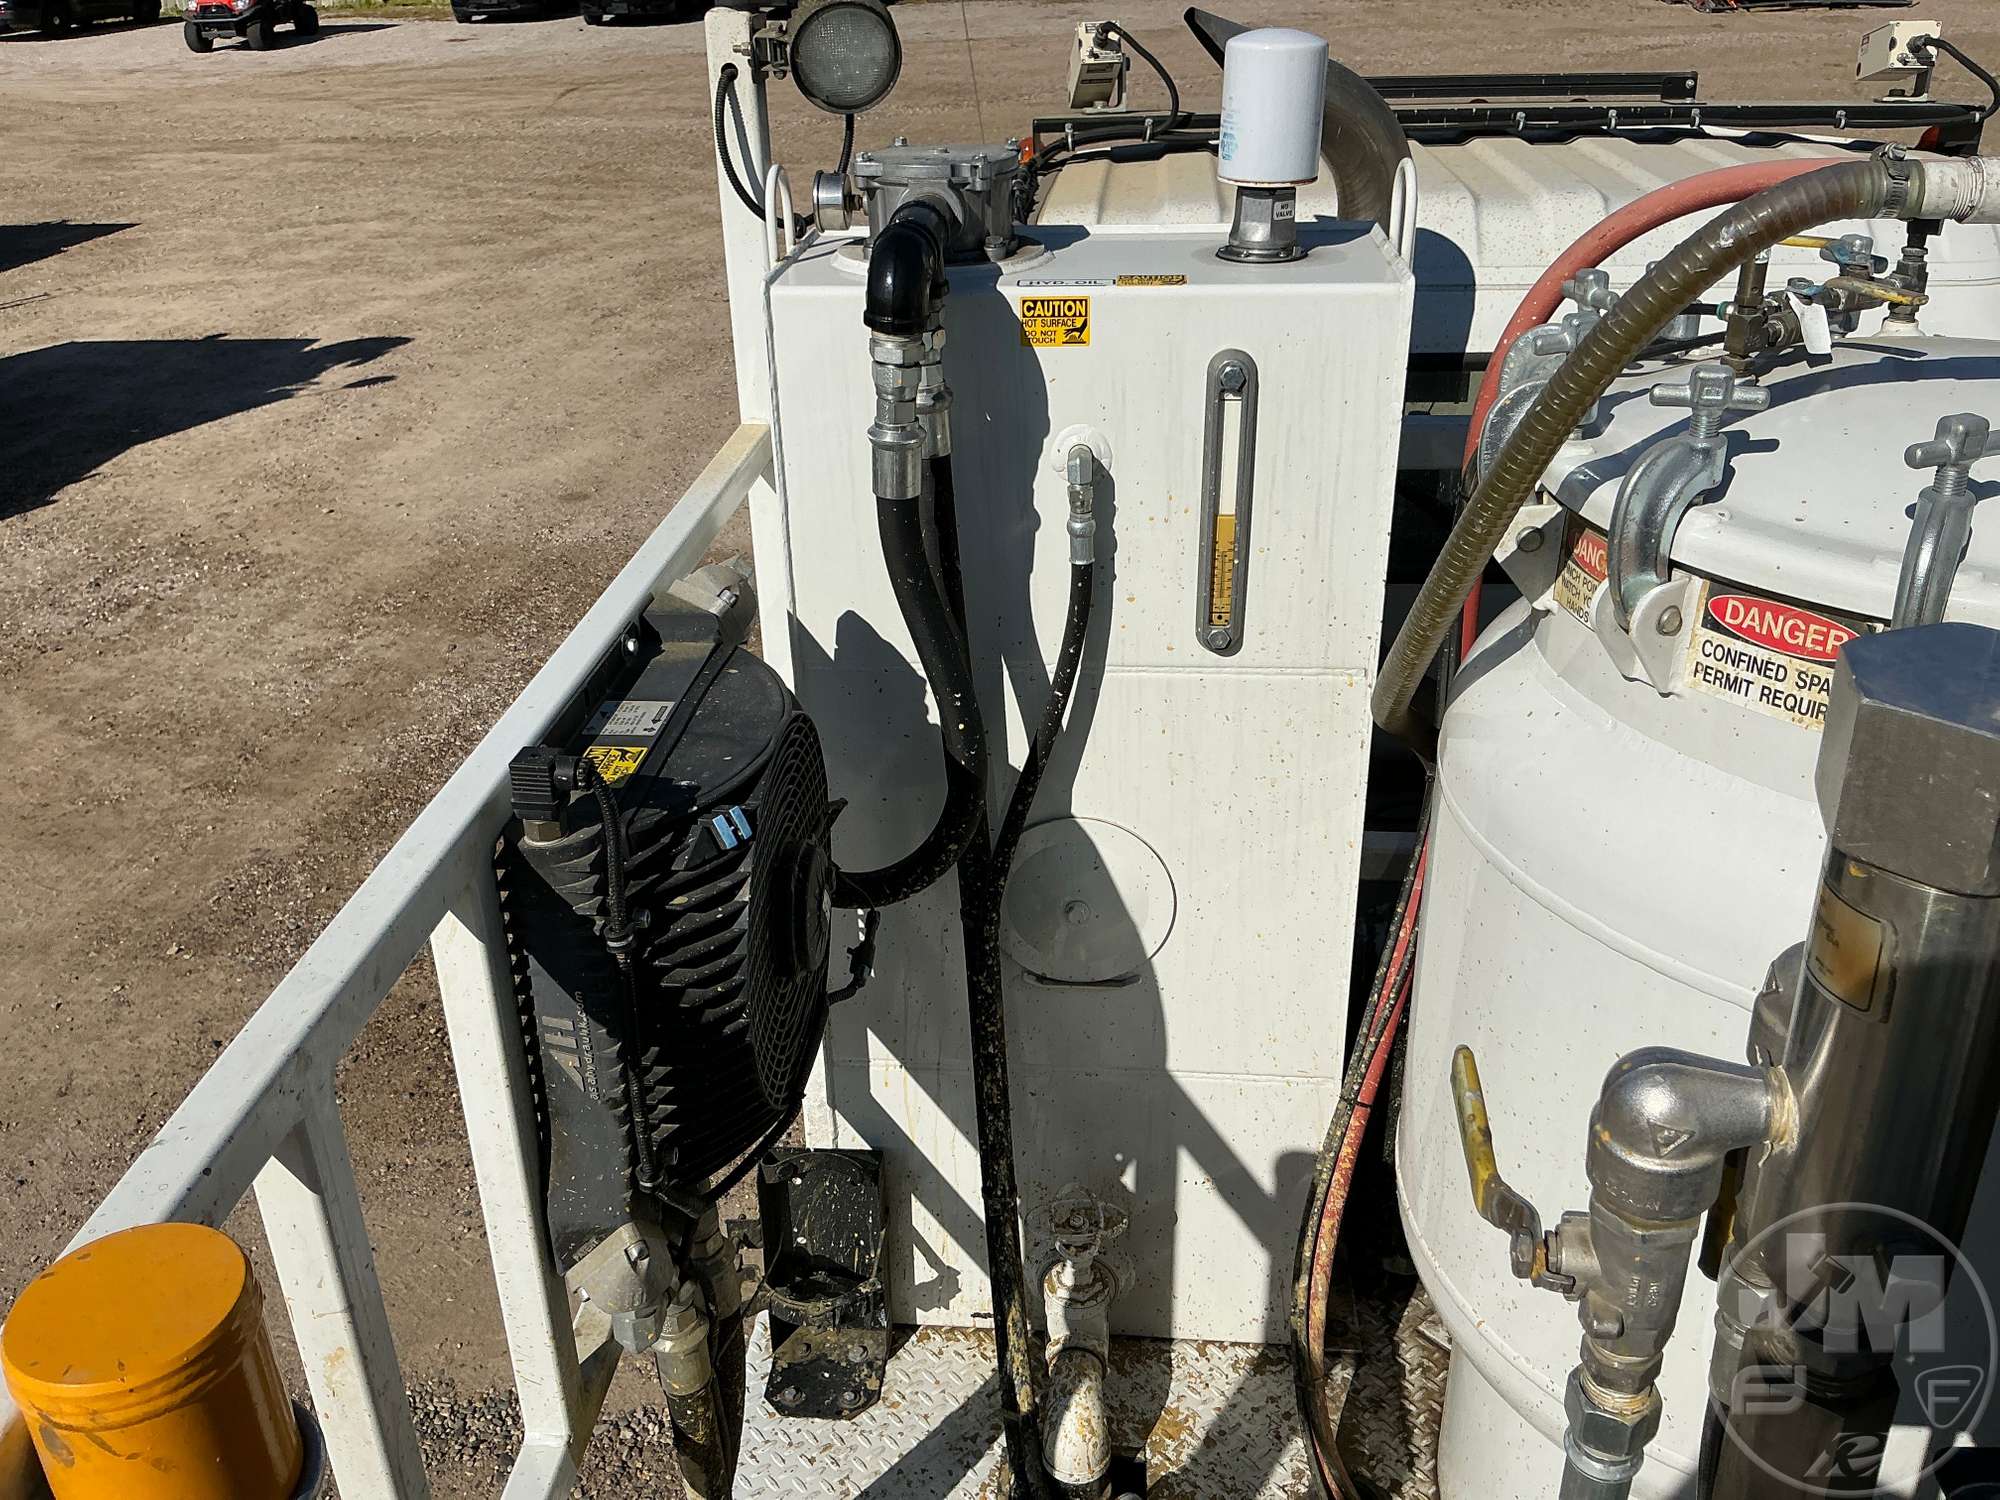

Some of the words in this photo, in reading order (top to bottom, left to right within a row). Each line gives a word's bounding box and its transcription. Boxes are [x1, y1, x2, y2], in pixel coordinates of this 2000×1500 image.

[1023, 300, 1086, 317] CAUTION
[1022, 318, 1037, 328] HOT
[1040, 318, 1077, 328] SURFACE
[1566, 599, 1590, 623] HANDS
[1701, 639, 1788, 683] CONFINED
[1693, 660, 1755, 698] PERMIT
